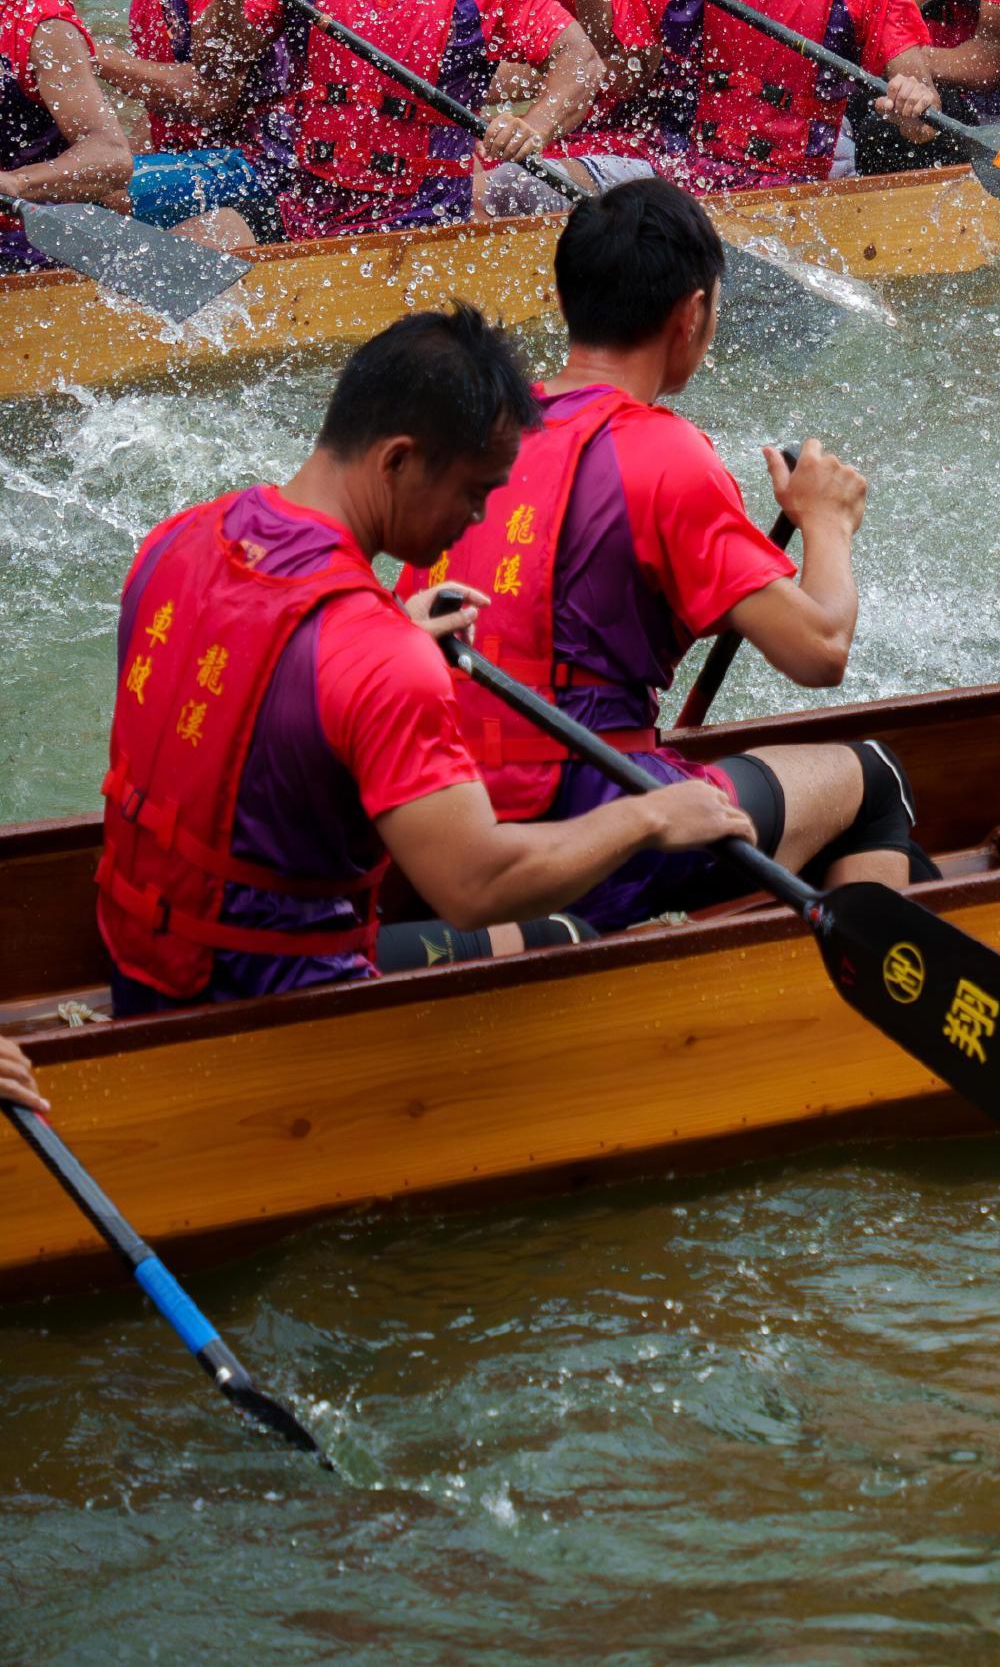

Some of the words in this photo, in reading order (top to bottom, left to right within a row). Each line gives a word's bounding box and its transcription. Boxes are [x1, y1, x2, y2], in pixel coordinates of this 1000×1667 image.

[493, 503, 537, 598] 龍溪
[126, 599, 174, 706] 車陂
[175, 643, 229, 748] 龍溪
